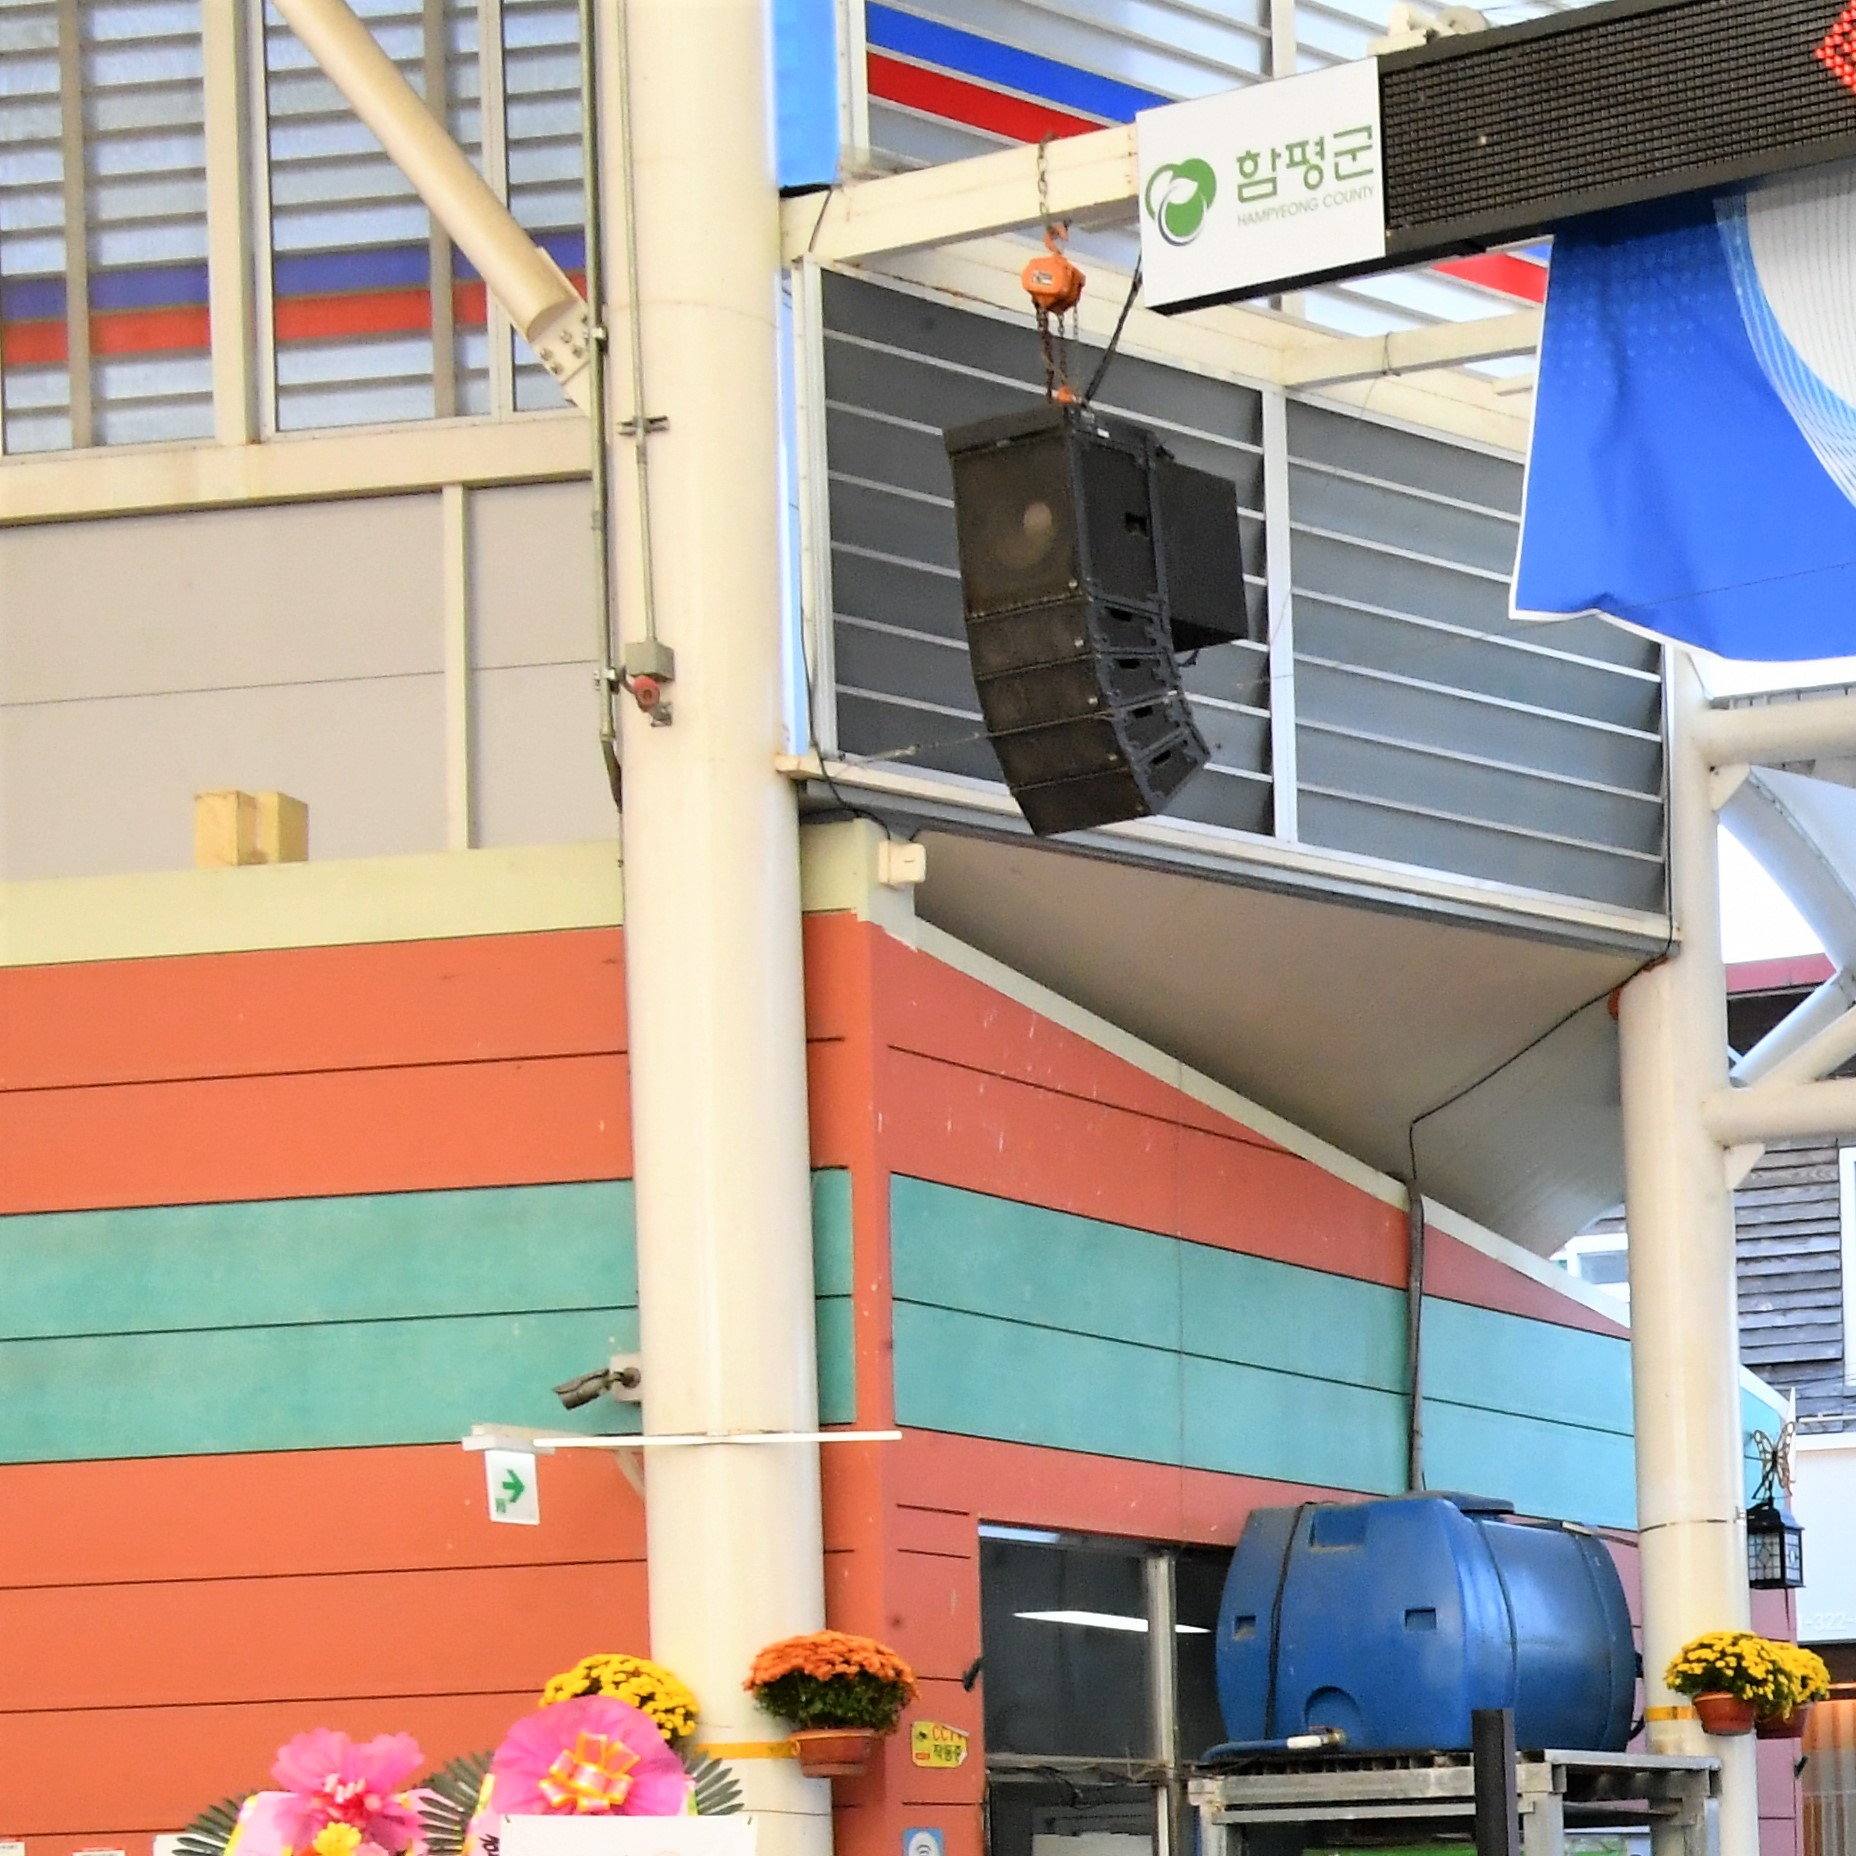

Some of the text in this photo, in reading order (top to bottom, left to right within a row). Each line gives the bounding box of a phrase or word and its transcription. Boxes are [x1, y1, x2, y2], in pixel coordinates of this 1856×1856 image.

[1235, 124, 1374, 203] 함평군
[1236, 184, 1375, 228] HAMPYEONG COUNTY
